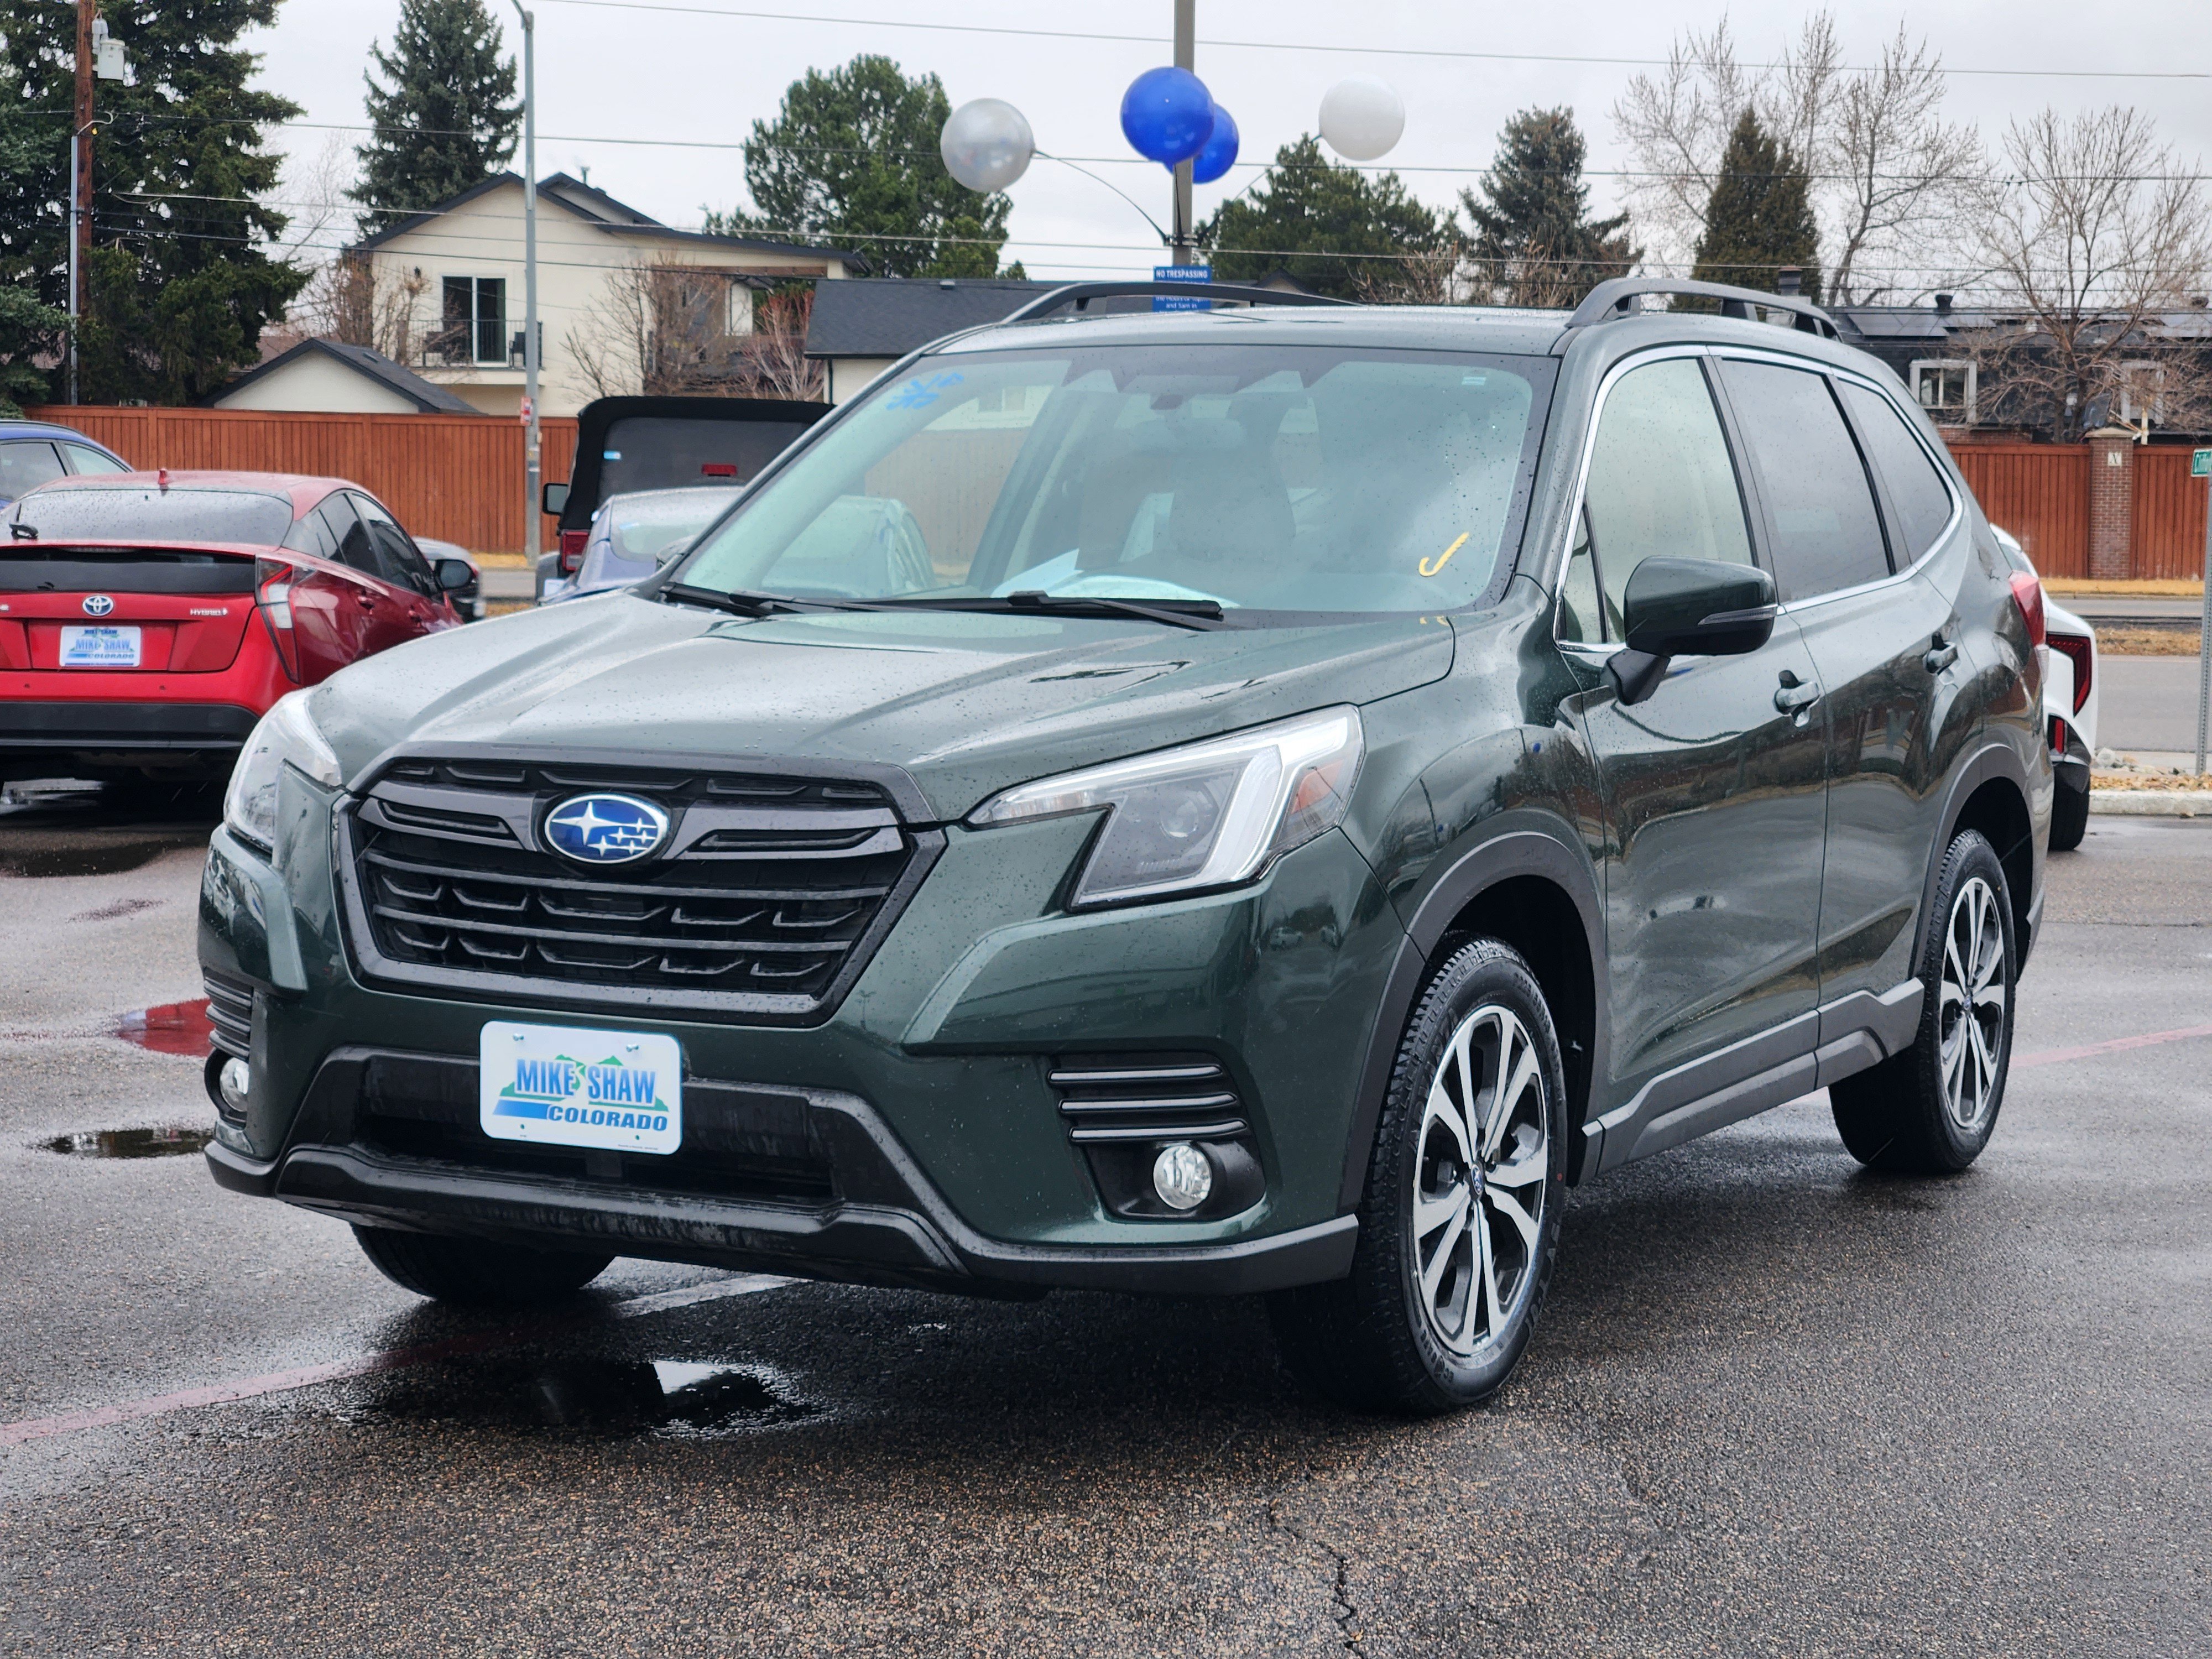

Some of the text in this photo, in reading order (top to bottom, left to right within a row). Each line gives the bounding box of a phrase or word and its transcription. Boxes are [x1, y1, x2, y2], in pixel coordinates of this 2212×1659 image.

[1156, 269, 1208, 279] NO TRESPASSING
[190, 607, 221, 616] HYBRID
[76, 639, 131, 651] MIKE SHAW
[516, 1058, 656, 1104] MIKE SHAW
[547, 1105, 668, 1132] COLORADO
